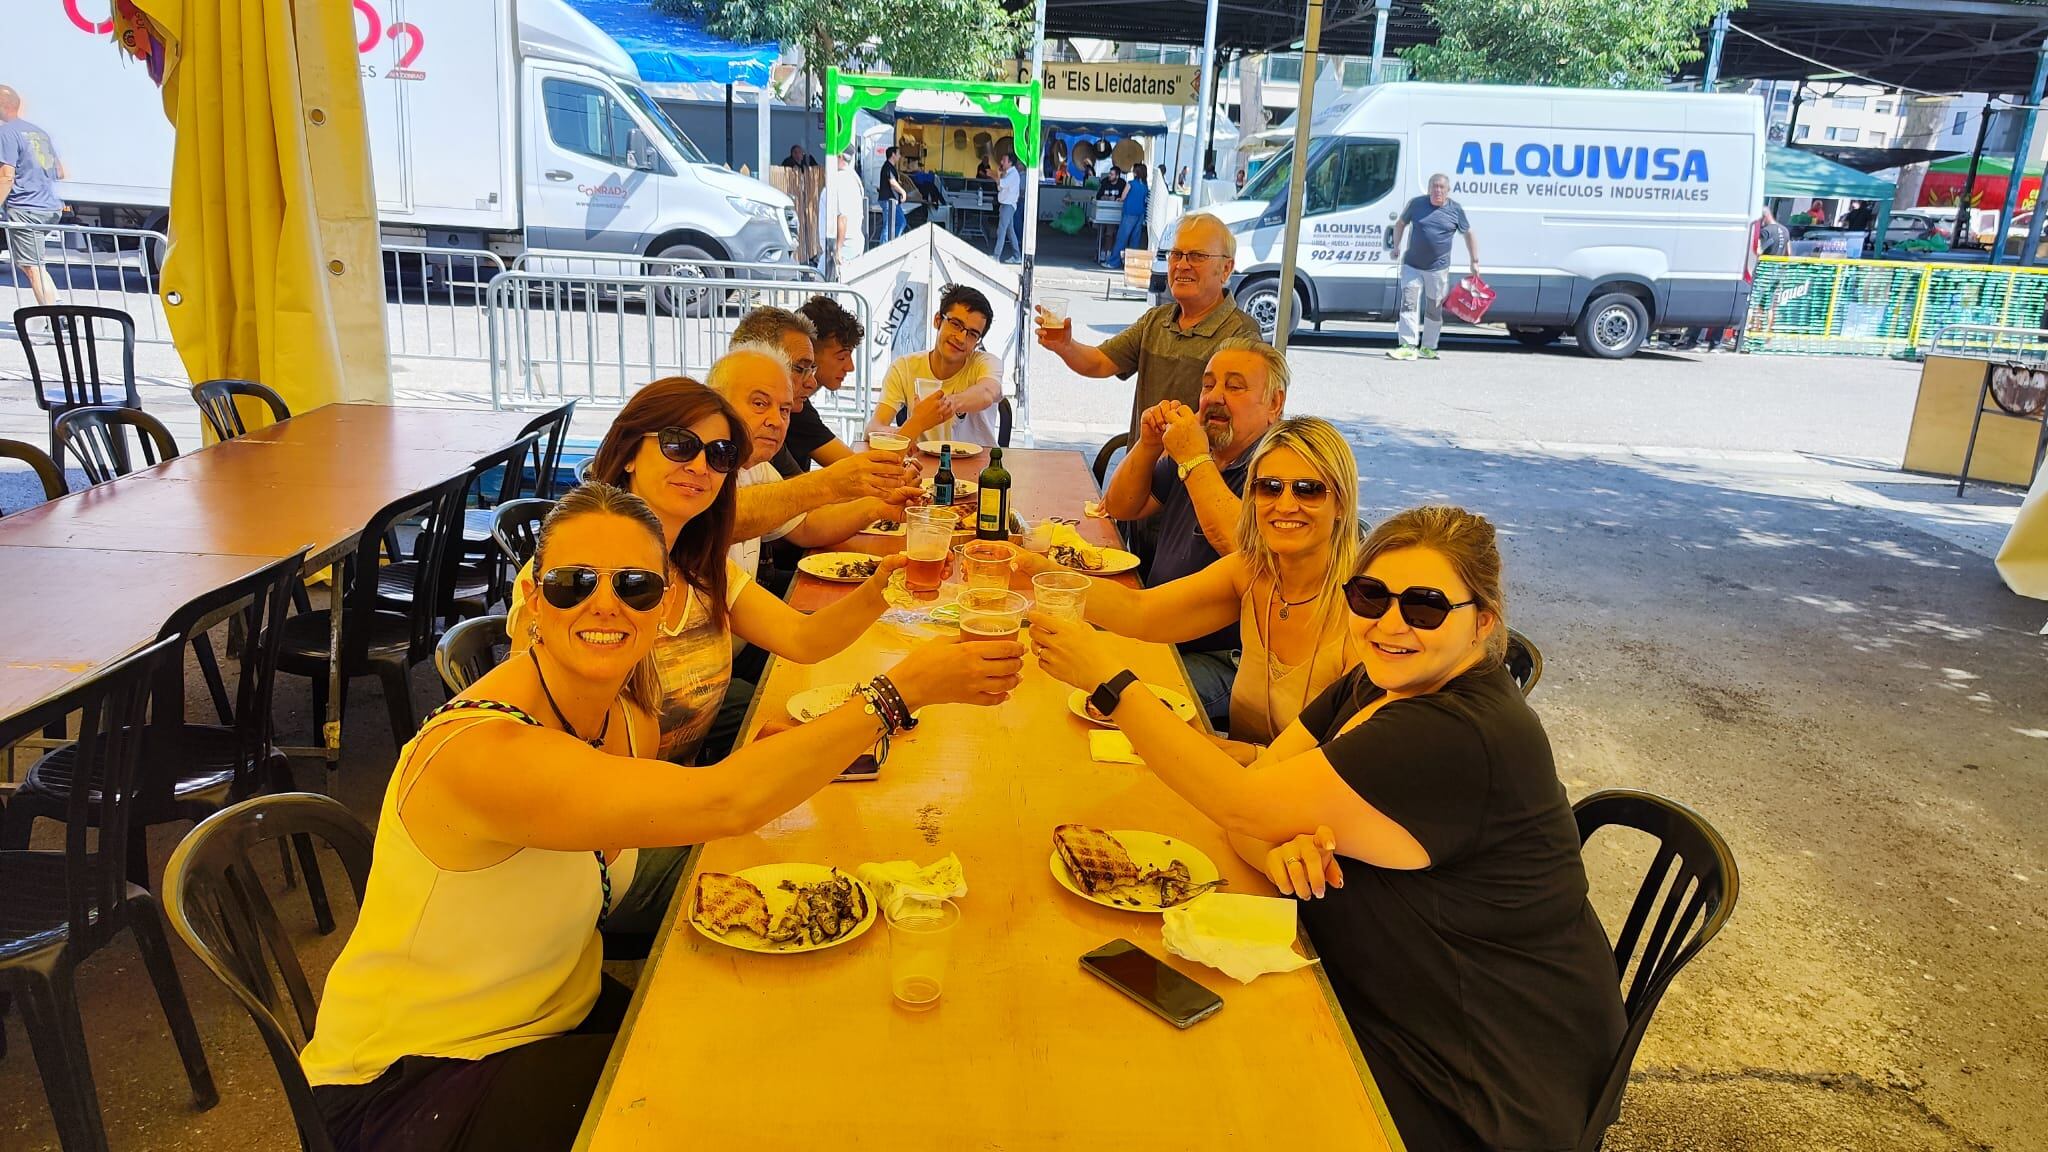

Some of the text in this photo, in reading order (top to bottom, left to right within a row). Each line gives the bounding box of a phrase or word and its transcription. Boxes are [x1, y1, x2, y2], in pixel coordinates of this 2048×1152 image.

[1018, 67, 1182, 96] Cla "Els Lleidatans"
[1456, 141, 1709, 183] ALQUIVISA
[1453, 181, 1709, 201] ALQUILER VEHÍCULOS INDUSTRIALES
[1314, 223, 1382, 234] ALQUIVISA
[1311, 250, 1382, 262] 902 44 15 15
